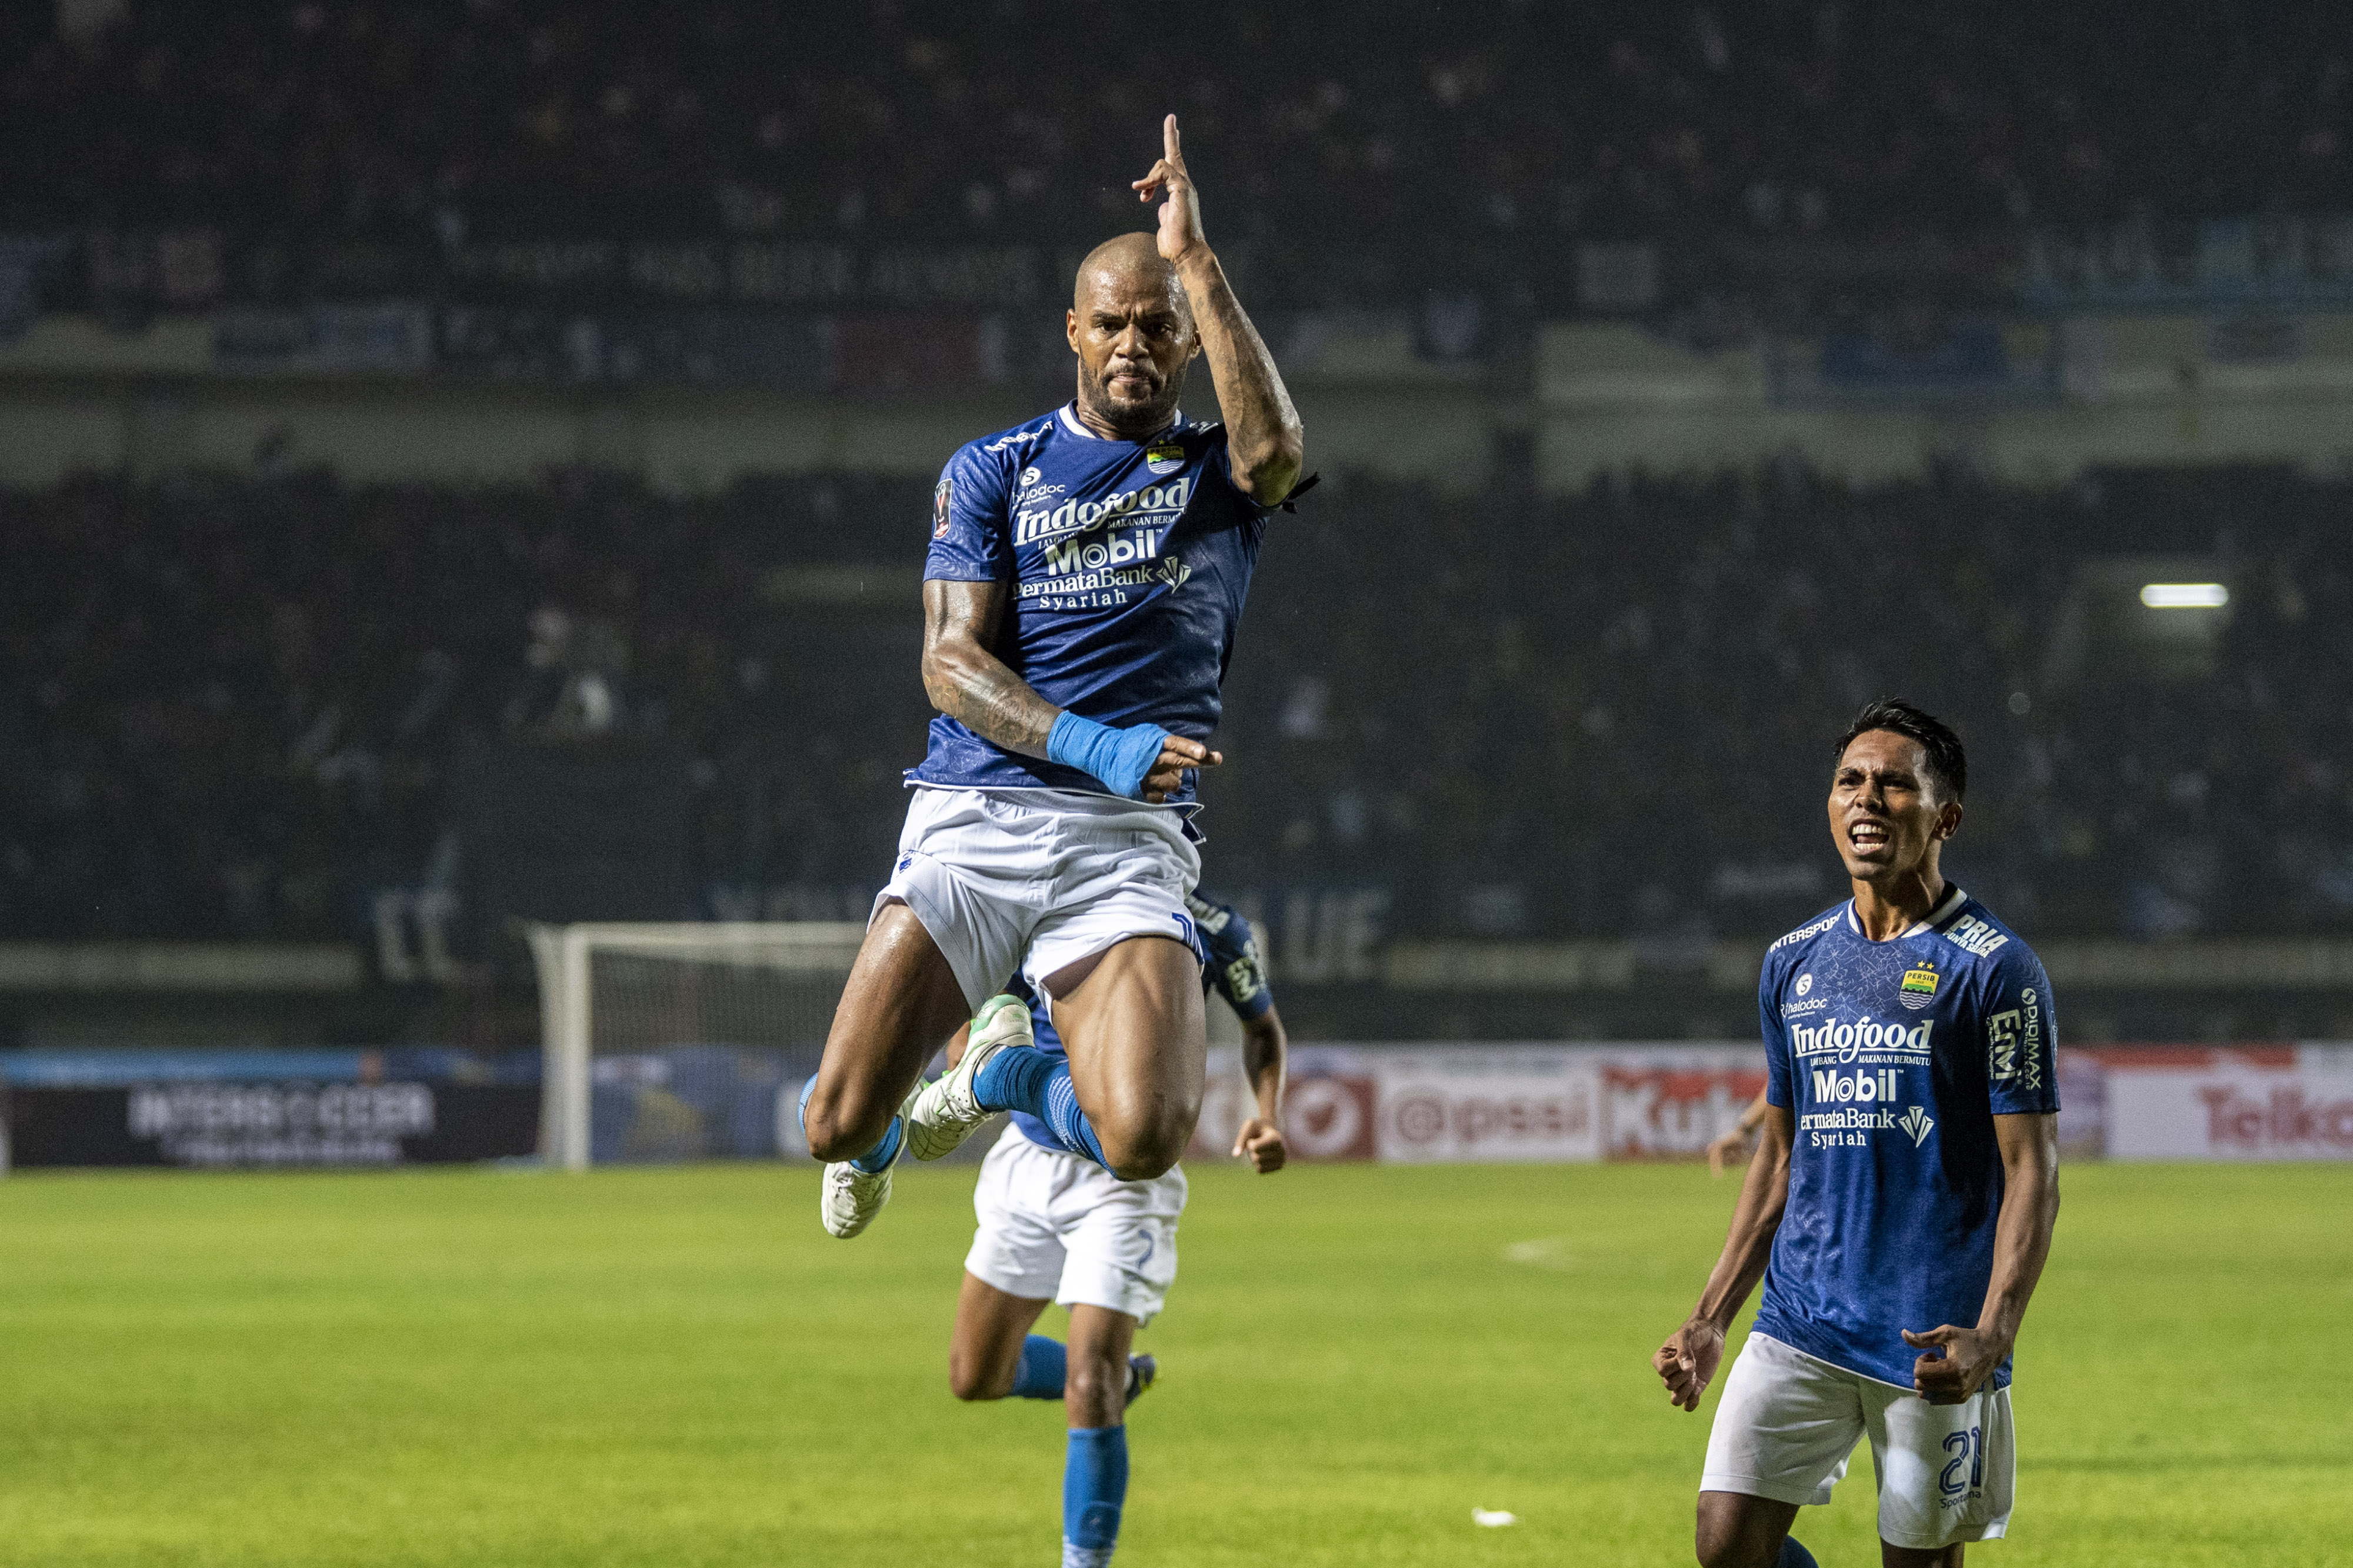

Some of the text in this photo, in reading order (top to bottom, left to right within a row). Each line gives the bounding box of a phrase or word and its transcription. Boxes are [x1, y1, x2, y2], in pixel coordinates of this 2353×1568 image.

[1012, 483, 1065, 504] halodoc
[1014, 477, 1189, 546] Indofood
[1107, 516, 1151, 529] MAKANAN
[1045, 529, 1156, 576] Mobil
[1039, 588, 1128, 610] Syariah
[1942, 929, 1991, 959] PUNYA SELERA
[1949, 913, 2009, 952] PRIA
[1907, 972, 1935, 982] PERSIB
[1787, 997, 1828, 1015] halodoc
[1791, 1015, 1934, 1064] Indofood
[2028, 1005, 2041, 1090] DIDIMAX
[1858, 1054, 1894, 1064] MAKANAN
[1894, 1055, 1932, 1066] BERMUTU
[1812, 1069, 1896, 1103] Mobil
[1801, 1108, 1896, 1130] ermataBank
[1811, 1130, 1867, 1150] Syariah
[1939, 1426, 1982, 1495] 21
